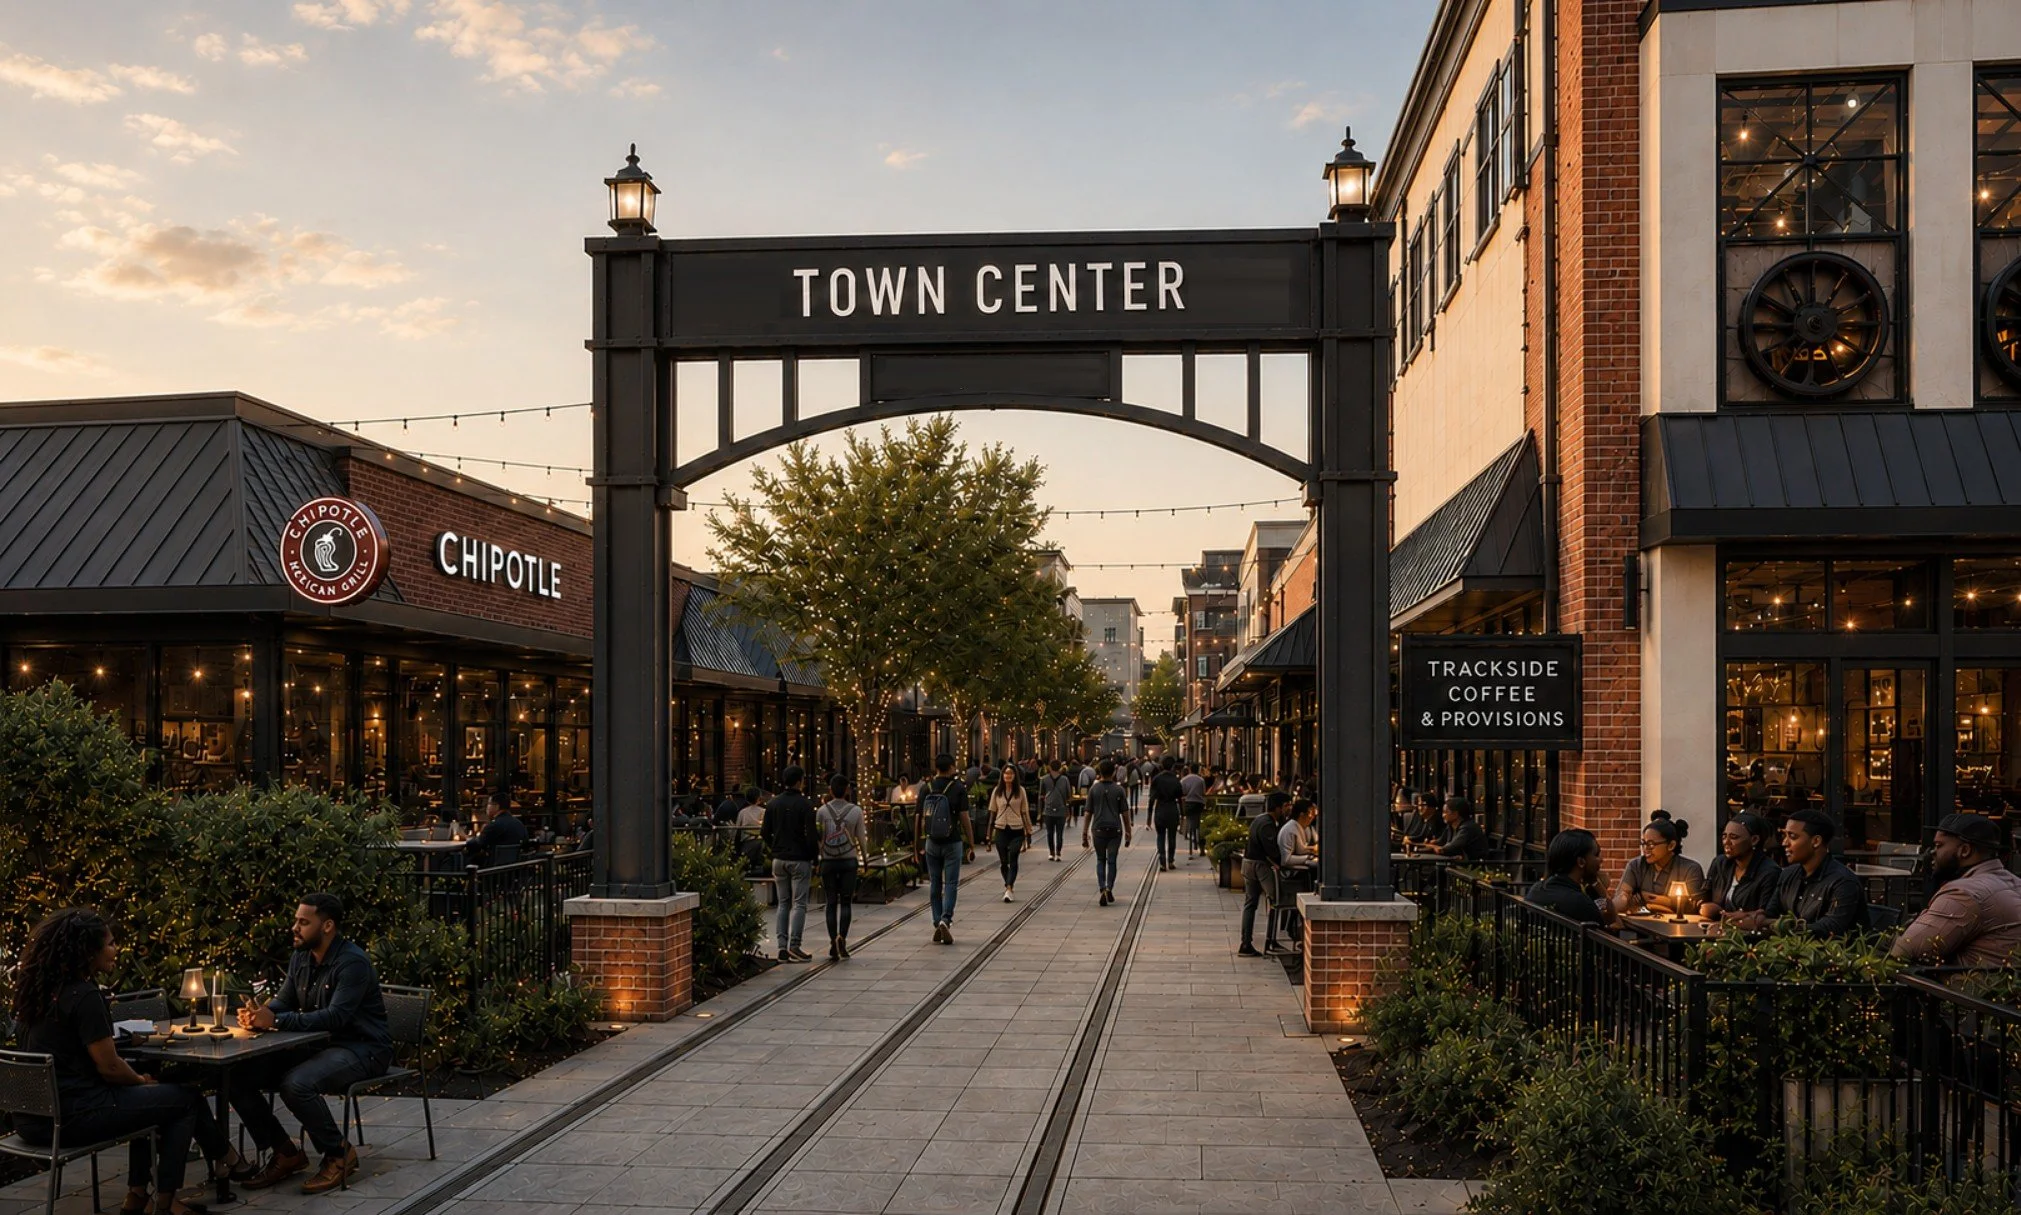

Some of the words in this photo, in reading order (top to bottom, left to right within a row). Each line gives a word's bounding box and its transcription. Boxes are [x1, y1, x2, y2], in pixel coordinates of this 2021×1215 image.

[793, 265, 945, 317] TOWN
[976, 261, 1186, 314] CENTER
[289, 505, 368, 539] CHIPOTLE
[439, 531, 562, 599] CHIPOTLE
[1427, 660, 1559, 677] TRACKSIDE
[1448, 686, 1536, 702] COFFEE
[1421, 711, 1434, 726] &
[1441, 711, 1564, 727] PROVISIONS
